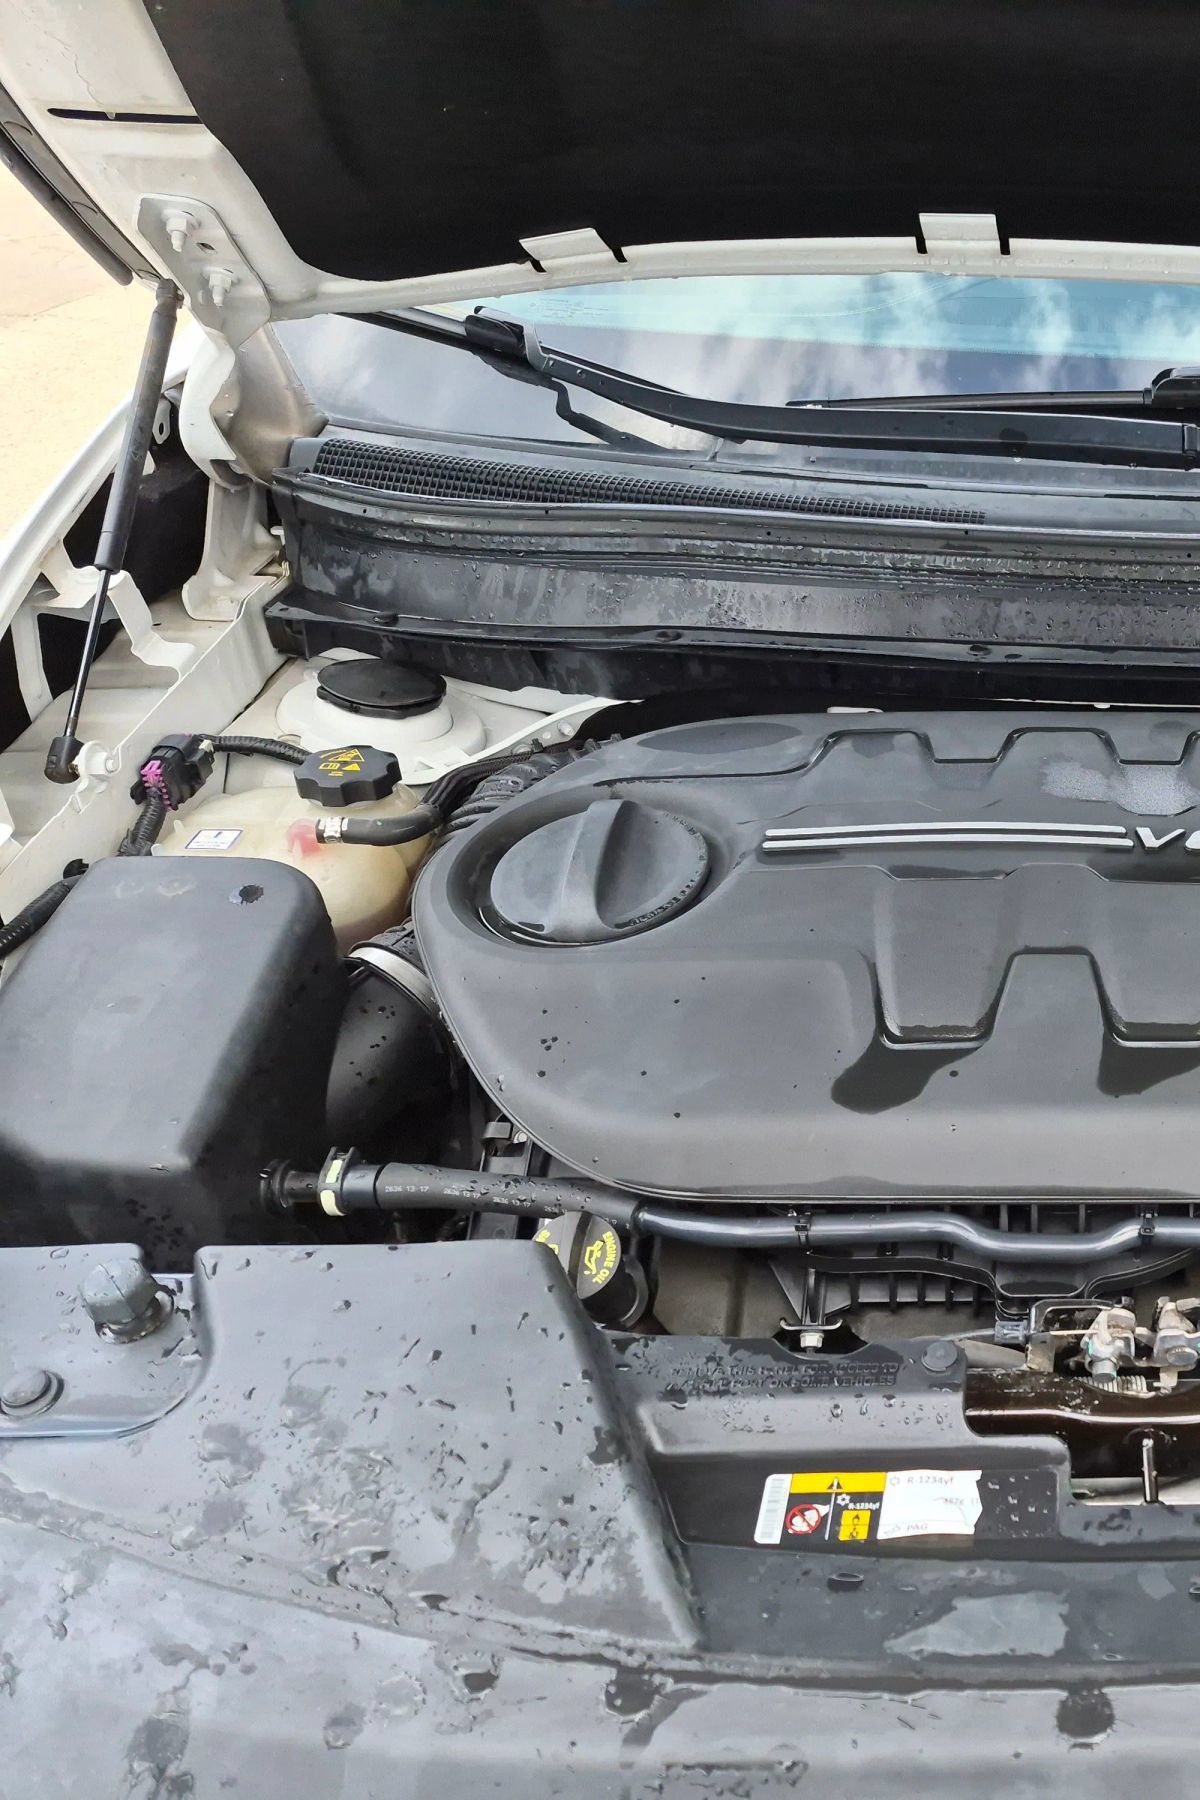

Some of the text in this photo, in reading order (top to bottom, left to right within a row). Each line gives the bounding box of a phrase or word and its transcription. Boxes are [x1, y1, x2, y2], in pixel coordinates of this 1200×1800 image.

[420, 1185, 430, 1193] 17
[592, 1231, 617, 1284] ENGINE OIL
[729, 1365, 756, 1376] THIS
[882, 1362, 899, 1373] TO
[768, 1378, 788, 1389] ON
[833, 1375, 895, 1387] VEHICLES
[907, 1475, 954, 1487] R-1234yf
